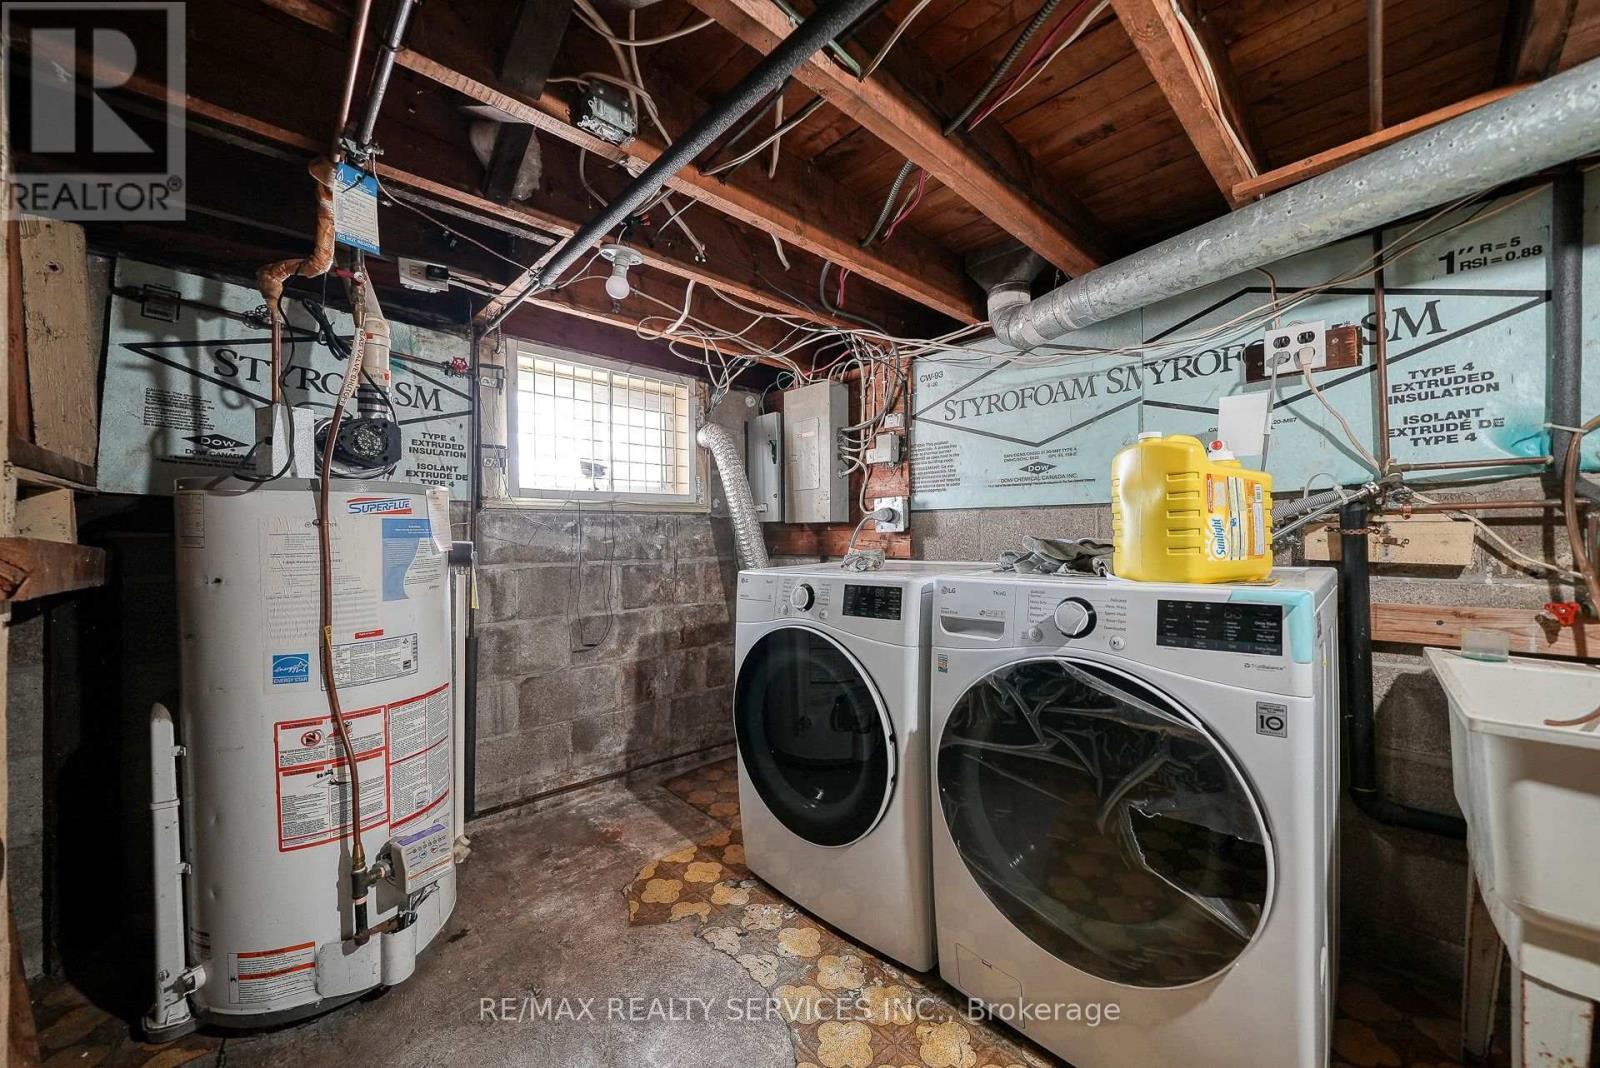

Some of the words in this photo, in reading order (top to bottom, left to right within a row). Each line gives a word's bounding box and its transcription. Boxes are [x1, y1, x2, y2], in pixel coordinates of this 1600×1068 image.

[1360, 300, 1447, 346] SM
[920, 370, 944, 383] CW-93
[1408, 364, 1456, 380] TYPE
[1462, 362, 1475, 372] 4
[1392, 371, 1495, 393] EXTRUDED
[395, 382, 443, 412] SM
[944, 375, 1098, 421] STYROFOAM
[1388, 382, 1500, 405] INSULATION
[1403, 408, 1484, 425] ISOLANT
[1388, 419, 1472, 438] EXTRUDÉ
[1478, 418, 1505, 430] DE
[200, 437, 236, 448] DOW
[421, 432, 447, 441] TYPE
[1410, 434, 1459, 447] TYPE
[1465, 432, 1477, 442] 4
[408, 446, 467, 459] INSULATION
[411, 439, 465, 451] EXTRUDED
[417, 462, 459, 473] ISOLANT
[1028, 464, 1050, 472] DOW
[420, 478, 446, 487] TYPE
[448, 480, 455, 488] 4
[1042, 473, 1066, 481] CANADA
[1211, 518, 1226, 555] Sunlight
